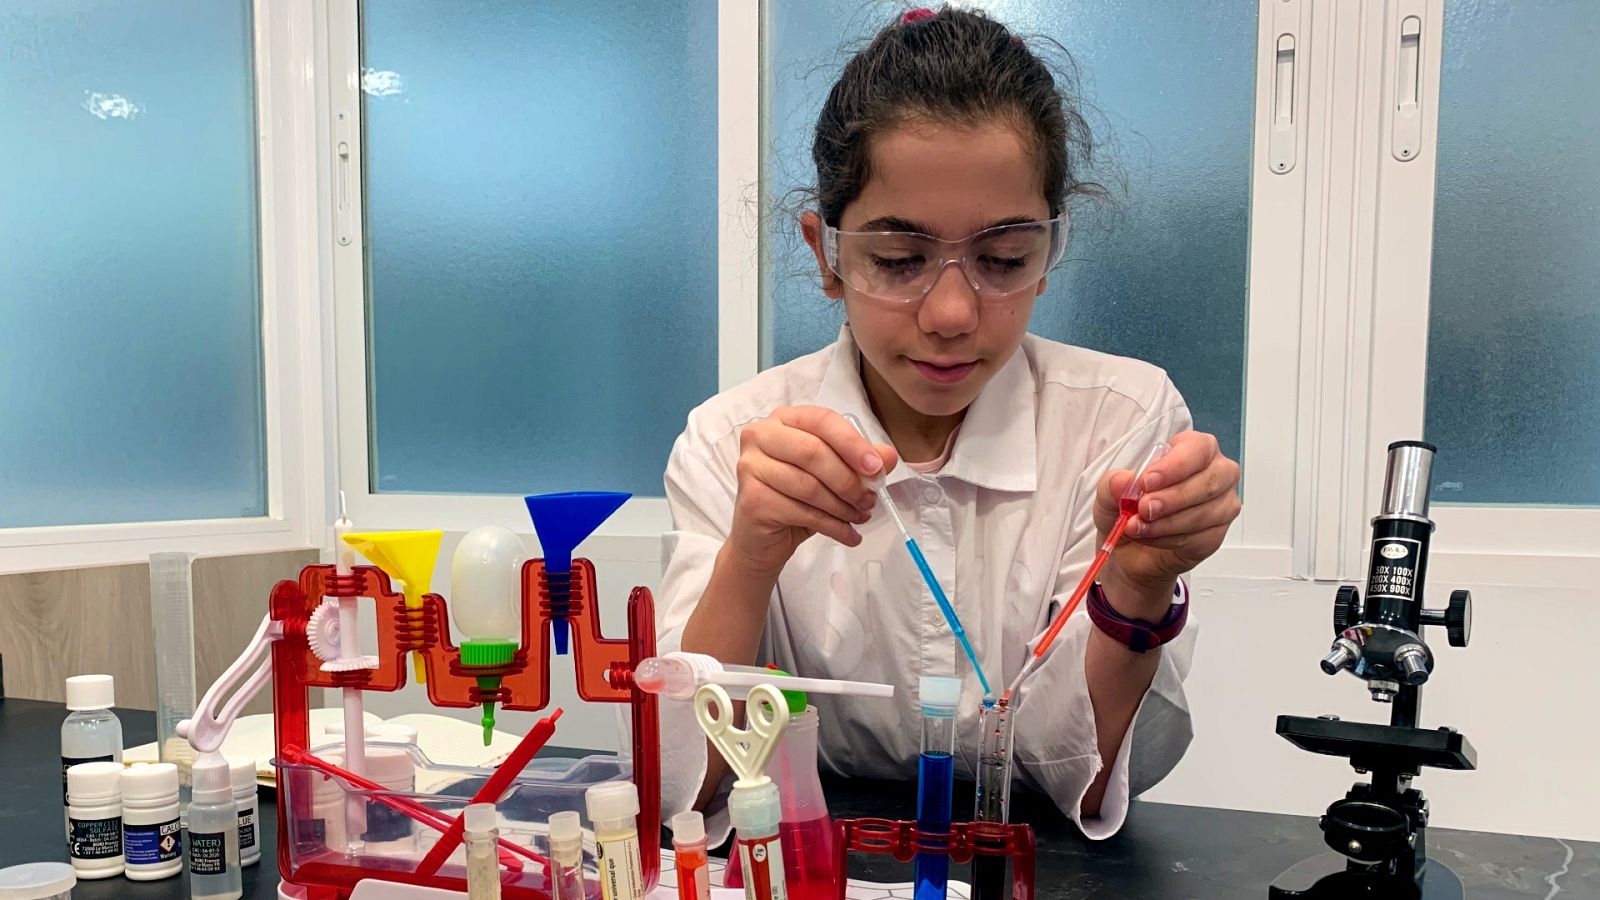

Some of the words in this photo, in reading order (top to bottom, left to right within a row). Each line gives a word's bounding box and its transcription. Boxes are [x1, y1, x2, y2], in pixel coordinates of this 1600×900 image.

[1376, 566, 1389, 574] 50X
[1393, 567, 1413, 577] 100X
[1391, 576, 1411, 586] 400X
[1390, 585, 1410, 595] 900X
[609, 870, 618, 897] universal
